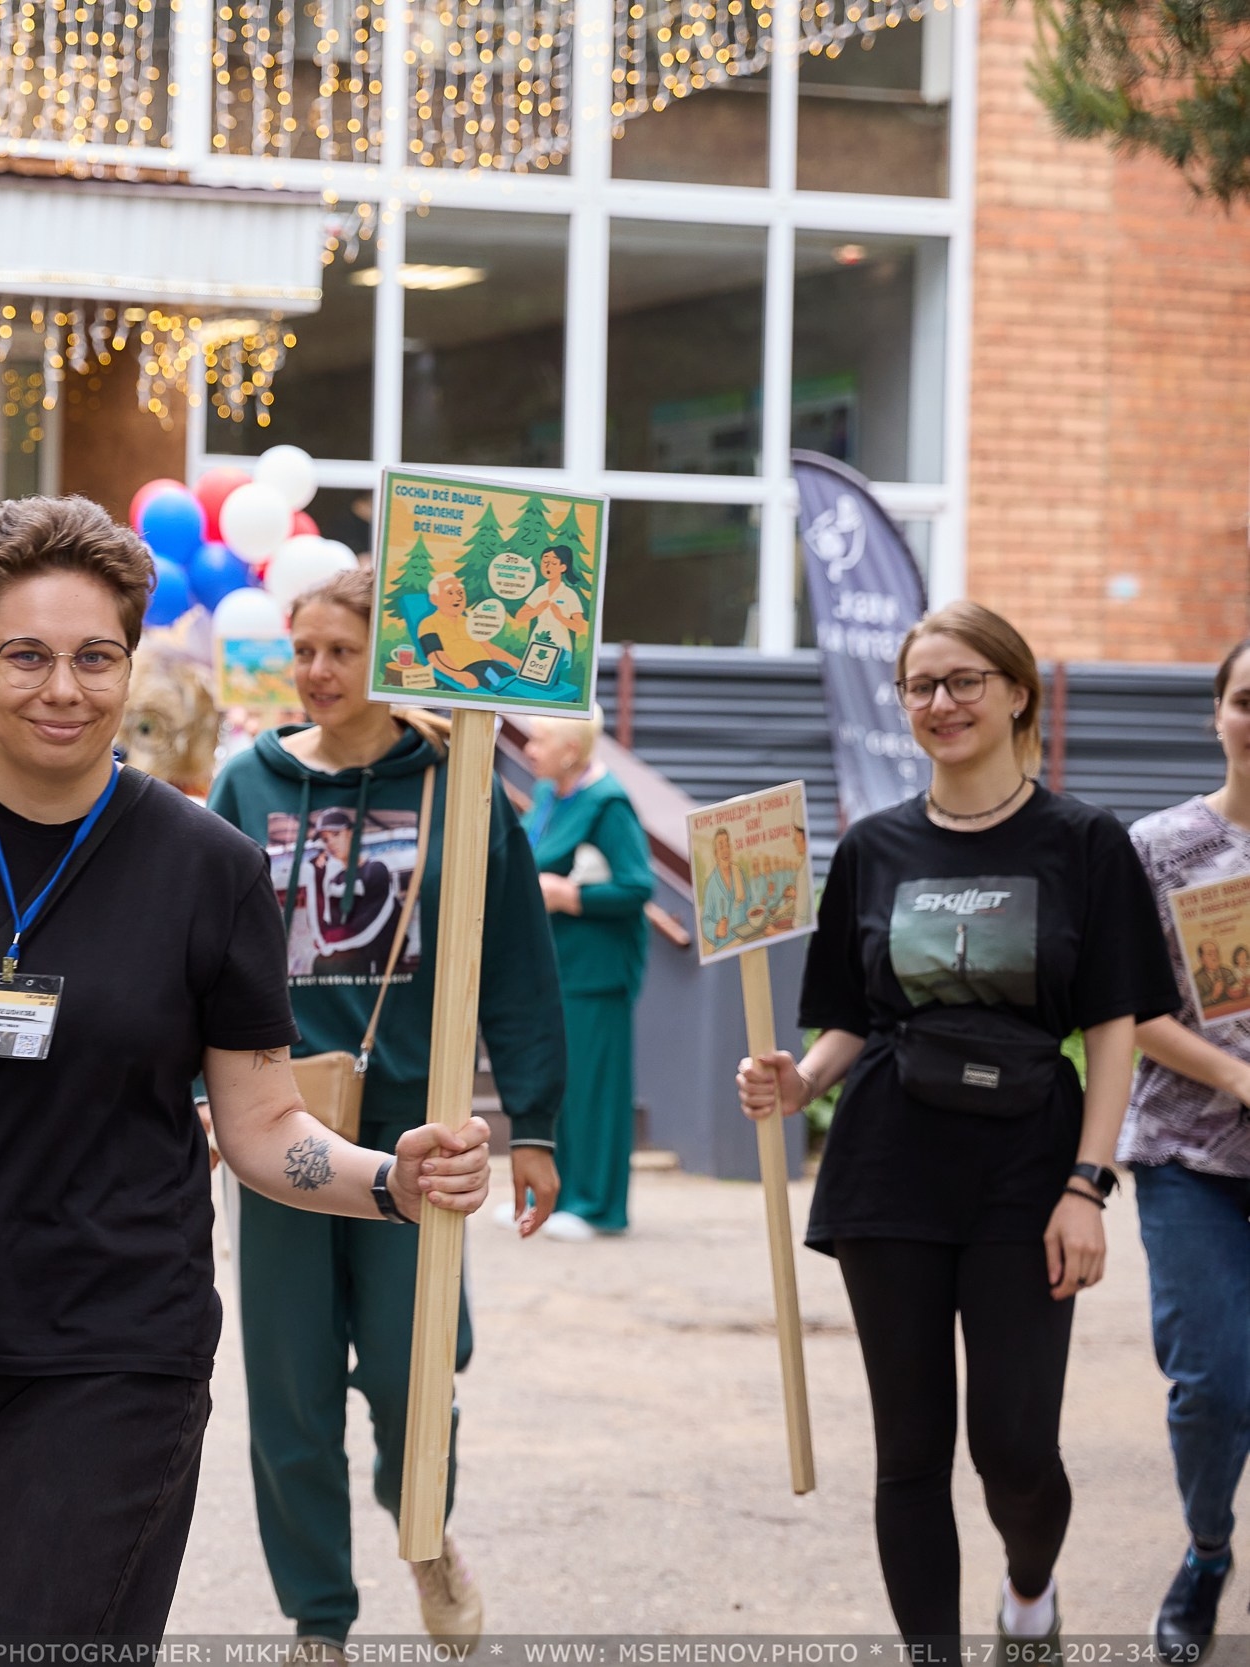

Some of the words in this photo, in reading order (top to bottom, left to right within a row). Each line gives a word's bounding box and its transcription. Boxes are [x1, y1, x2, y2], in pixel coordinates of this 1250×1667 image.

[395, 485, 429, 499] СОСНЫ
[432, 488, 449, 501] ВСЁ
[452, 492, 484, 507] ВЫШЕ,
[414, 505, 464, 520] ДАВЛЕНИЕ
[414, 520, 431, 533] ВСЁ
[434, 524, 462, 537] НИЖЕ
[912, 888, 1012, 915] SKILLET
